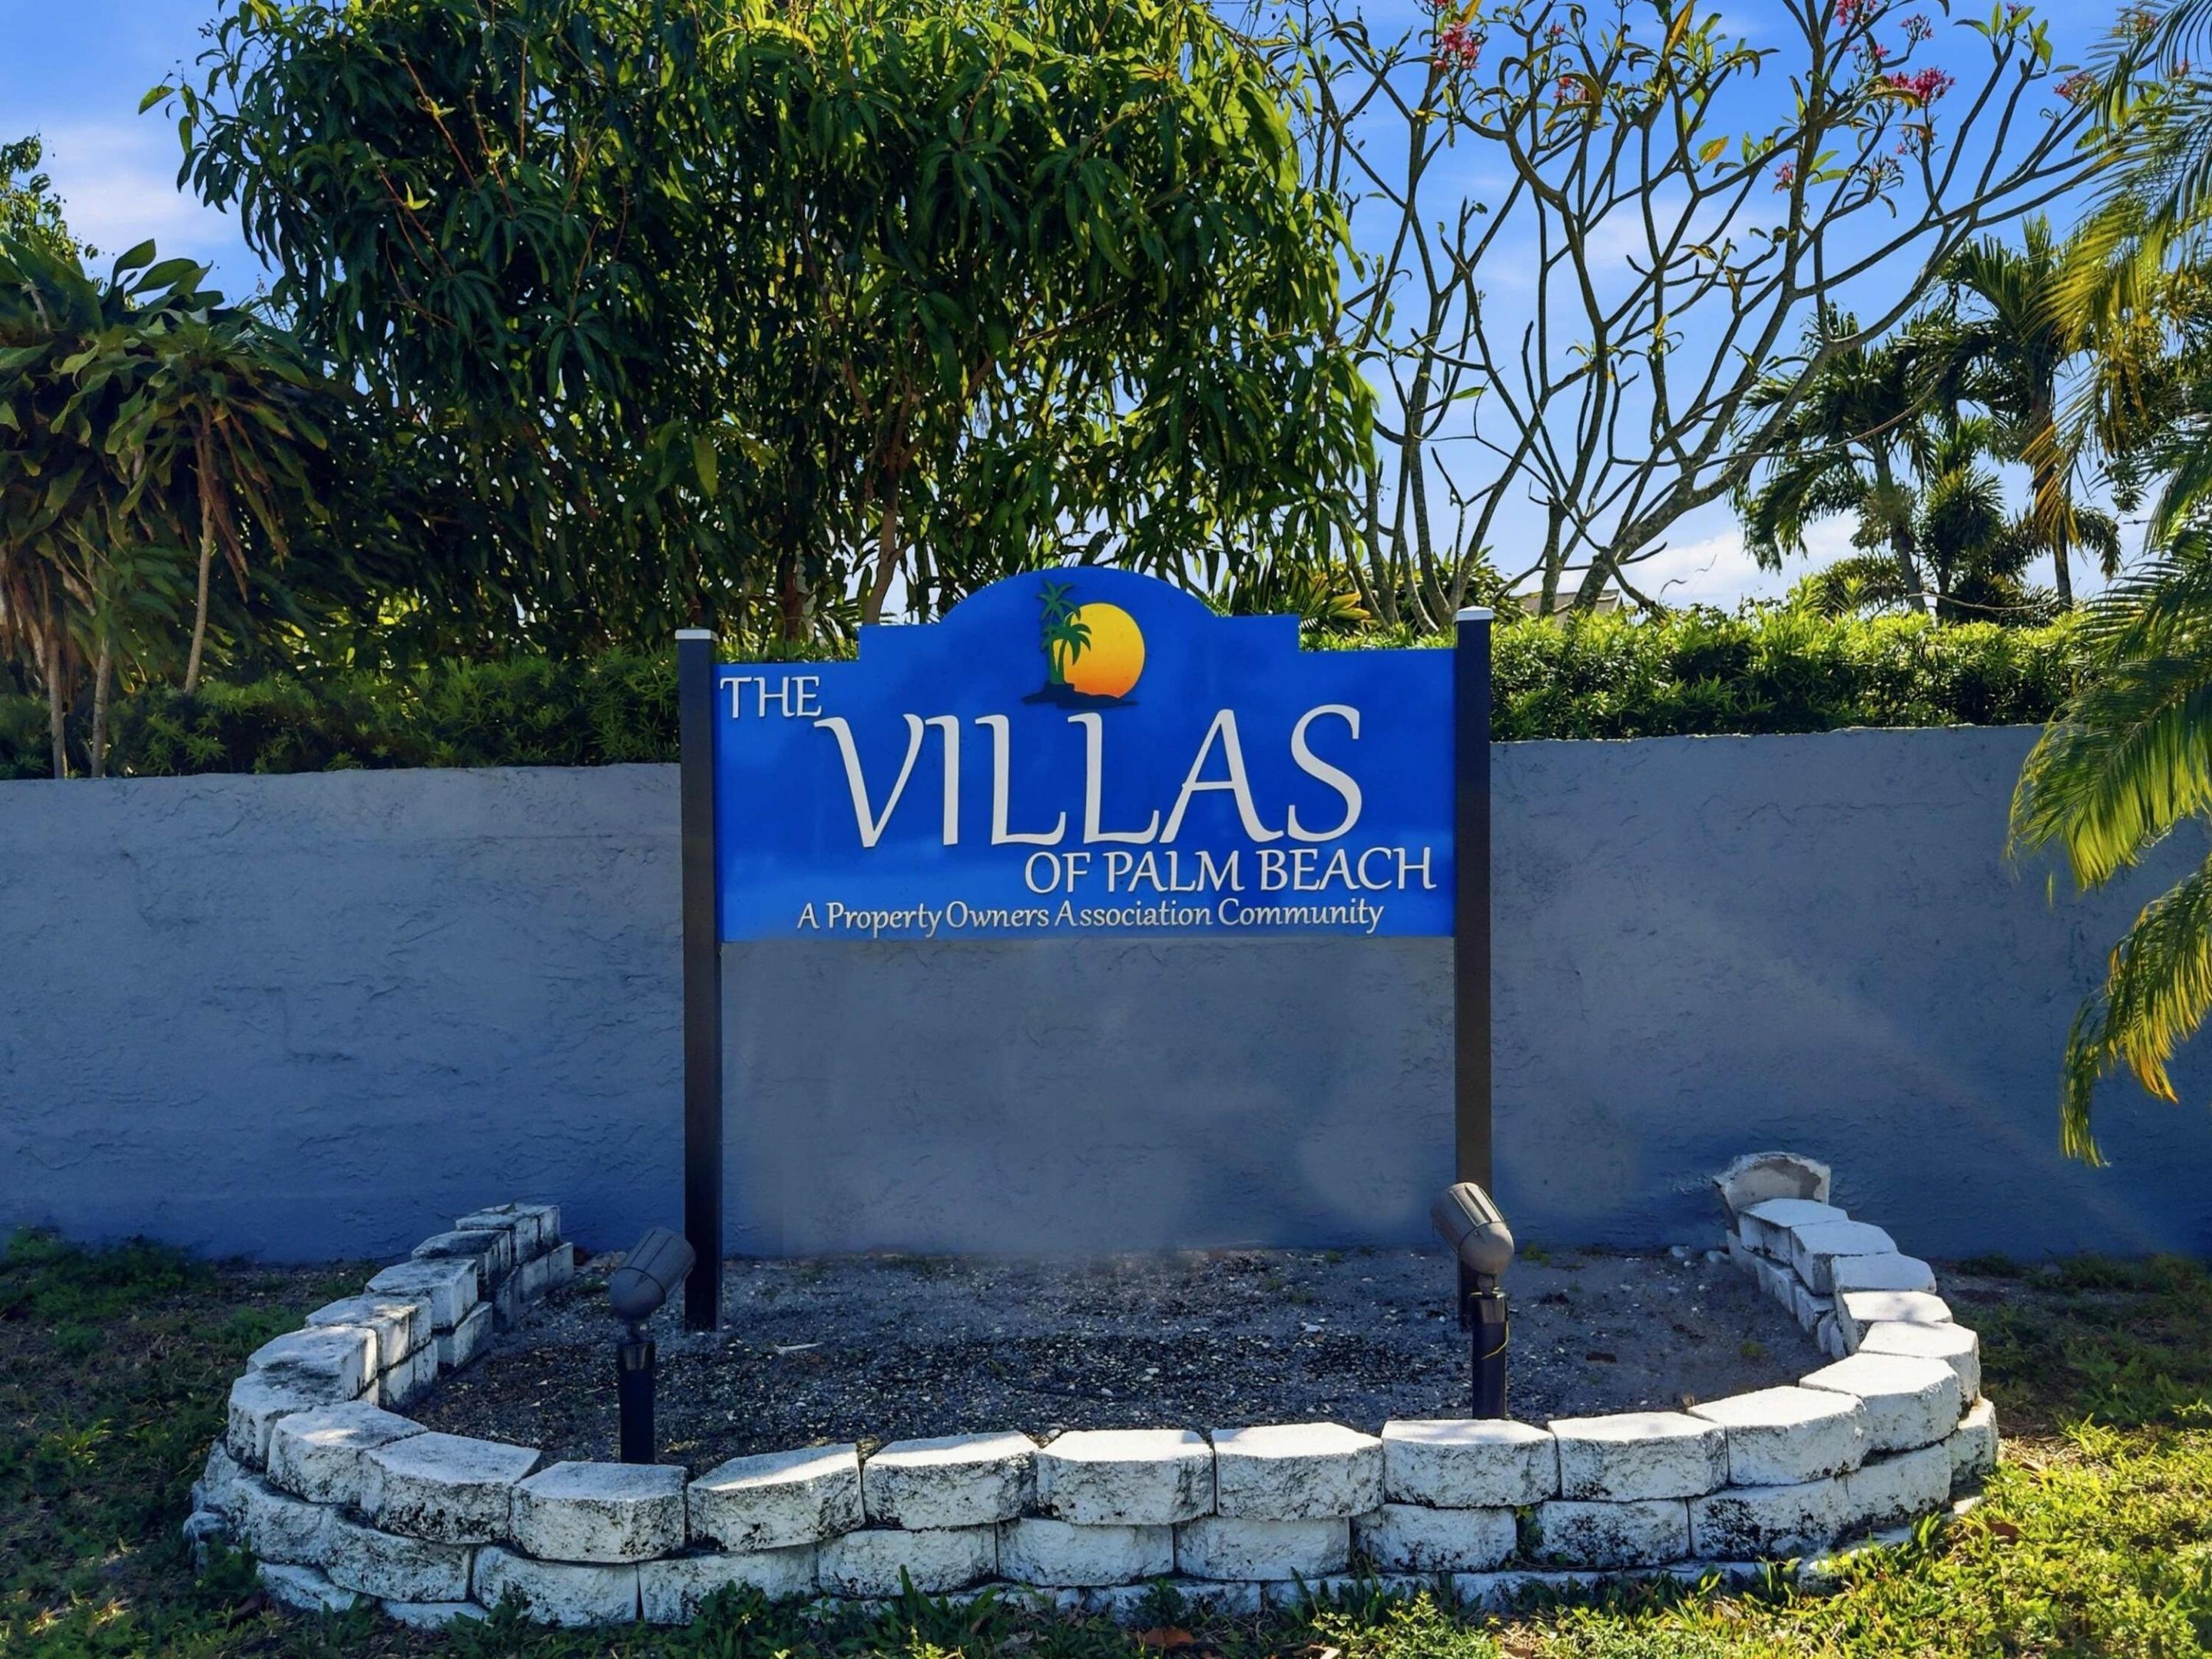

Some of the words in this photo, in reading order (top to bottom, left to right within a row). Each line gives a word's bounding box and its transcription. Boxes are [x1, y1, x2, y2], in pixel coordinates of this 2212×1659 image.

[720, 676, 822, 718] THE
[813, 704, 1363, 848] VILLAS
[1025, 851, 1091, 894] OF
[1104, 850, 1245, 892] PALM
[1257, 846, 1437, 891] BEACH
[797, 902, 820, 929] A
[826, 902, 942, 939] Property
[946, 901, 1049, 928] Owners
[1055, 899, 1213, 927] Association
[1218, 897, 1385, 935] Community
